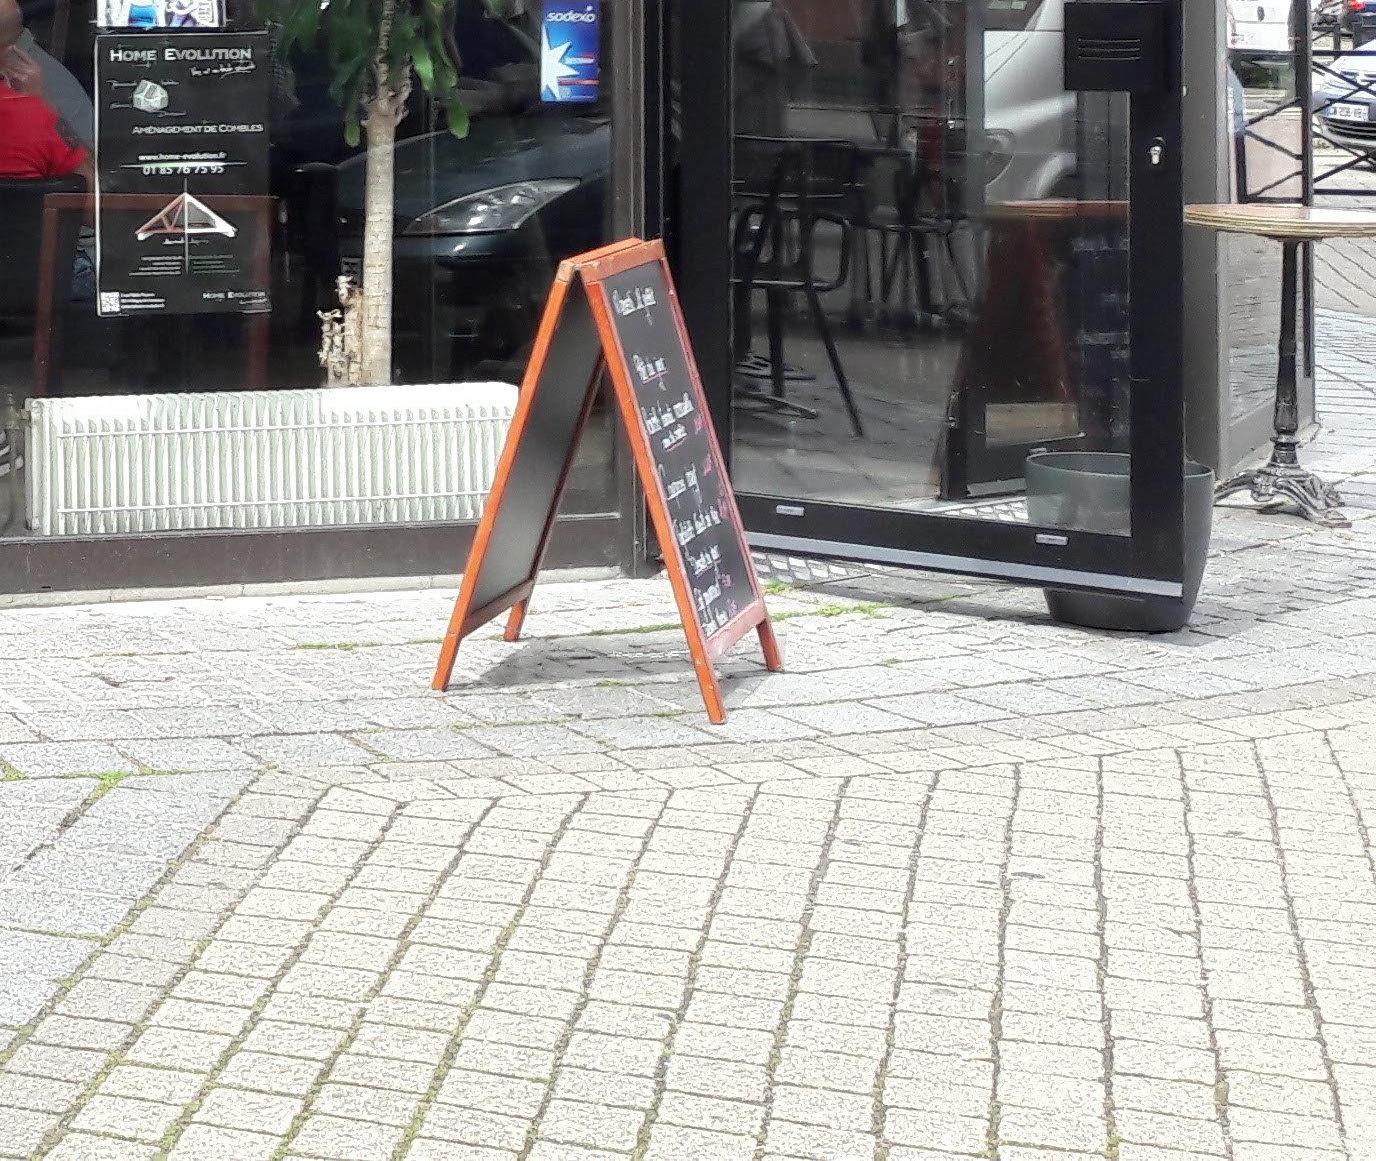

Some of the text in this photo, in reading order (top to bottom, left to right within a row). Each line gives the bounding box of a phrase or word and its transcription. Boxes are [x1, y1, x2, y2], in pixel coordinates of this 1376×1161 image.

[547, 7, 596, 23] sodexo
[109, 48, 252, 62] HOME EVOLUTION
